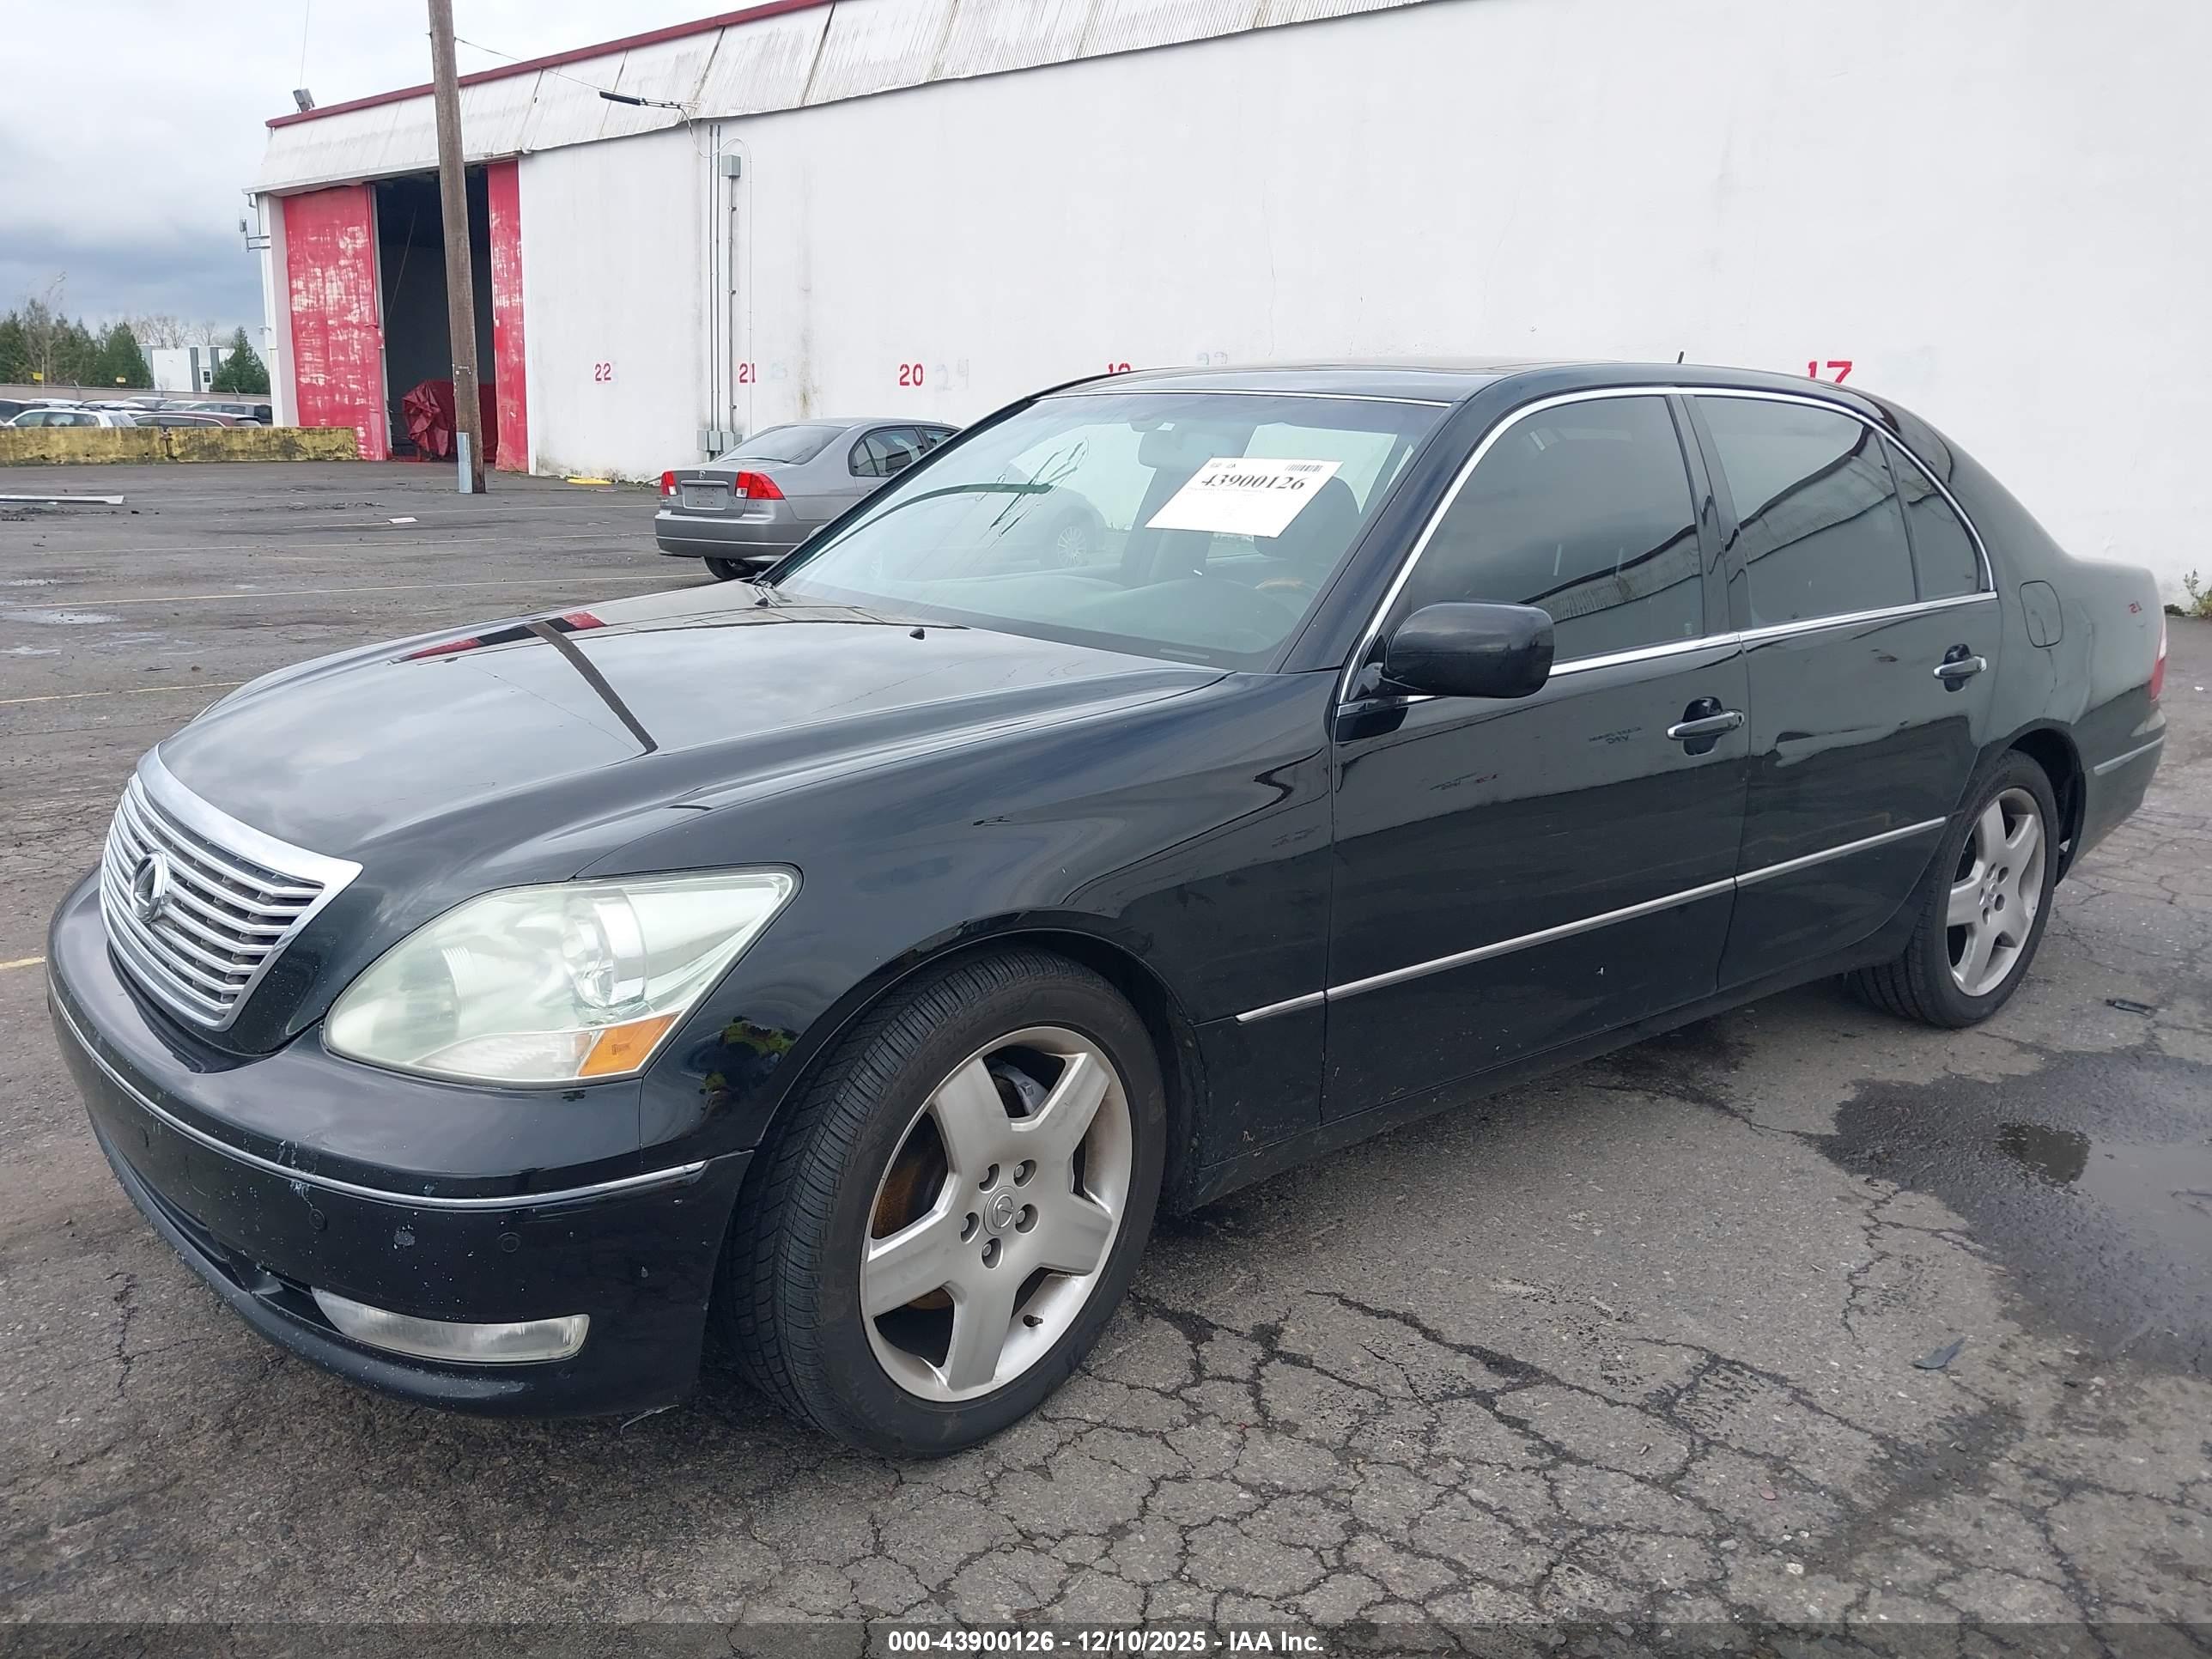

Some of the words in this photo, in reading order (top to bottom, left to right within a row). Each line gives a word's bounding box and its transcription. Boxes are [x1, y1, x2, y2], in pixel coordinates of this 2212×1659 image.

[594, 362, 612, 382] 22
[738, 362, 757, 383] 21
[898, 363, 924, 386] 20
[1808, 361, 1853, 384] 17
[1200, 473, 1309, 490] 43900126
